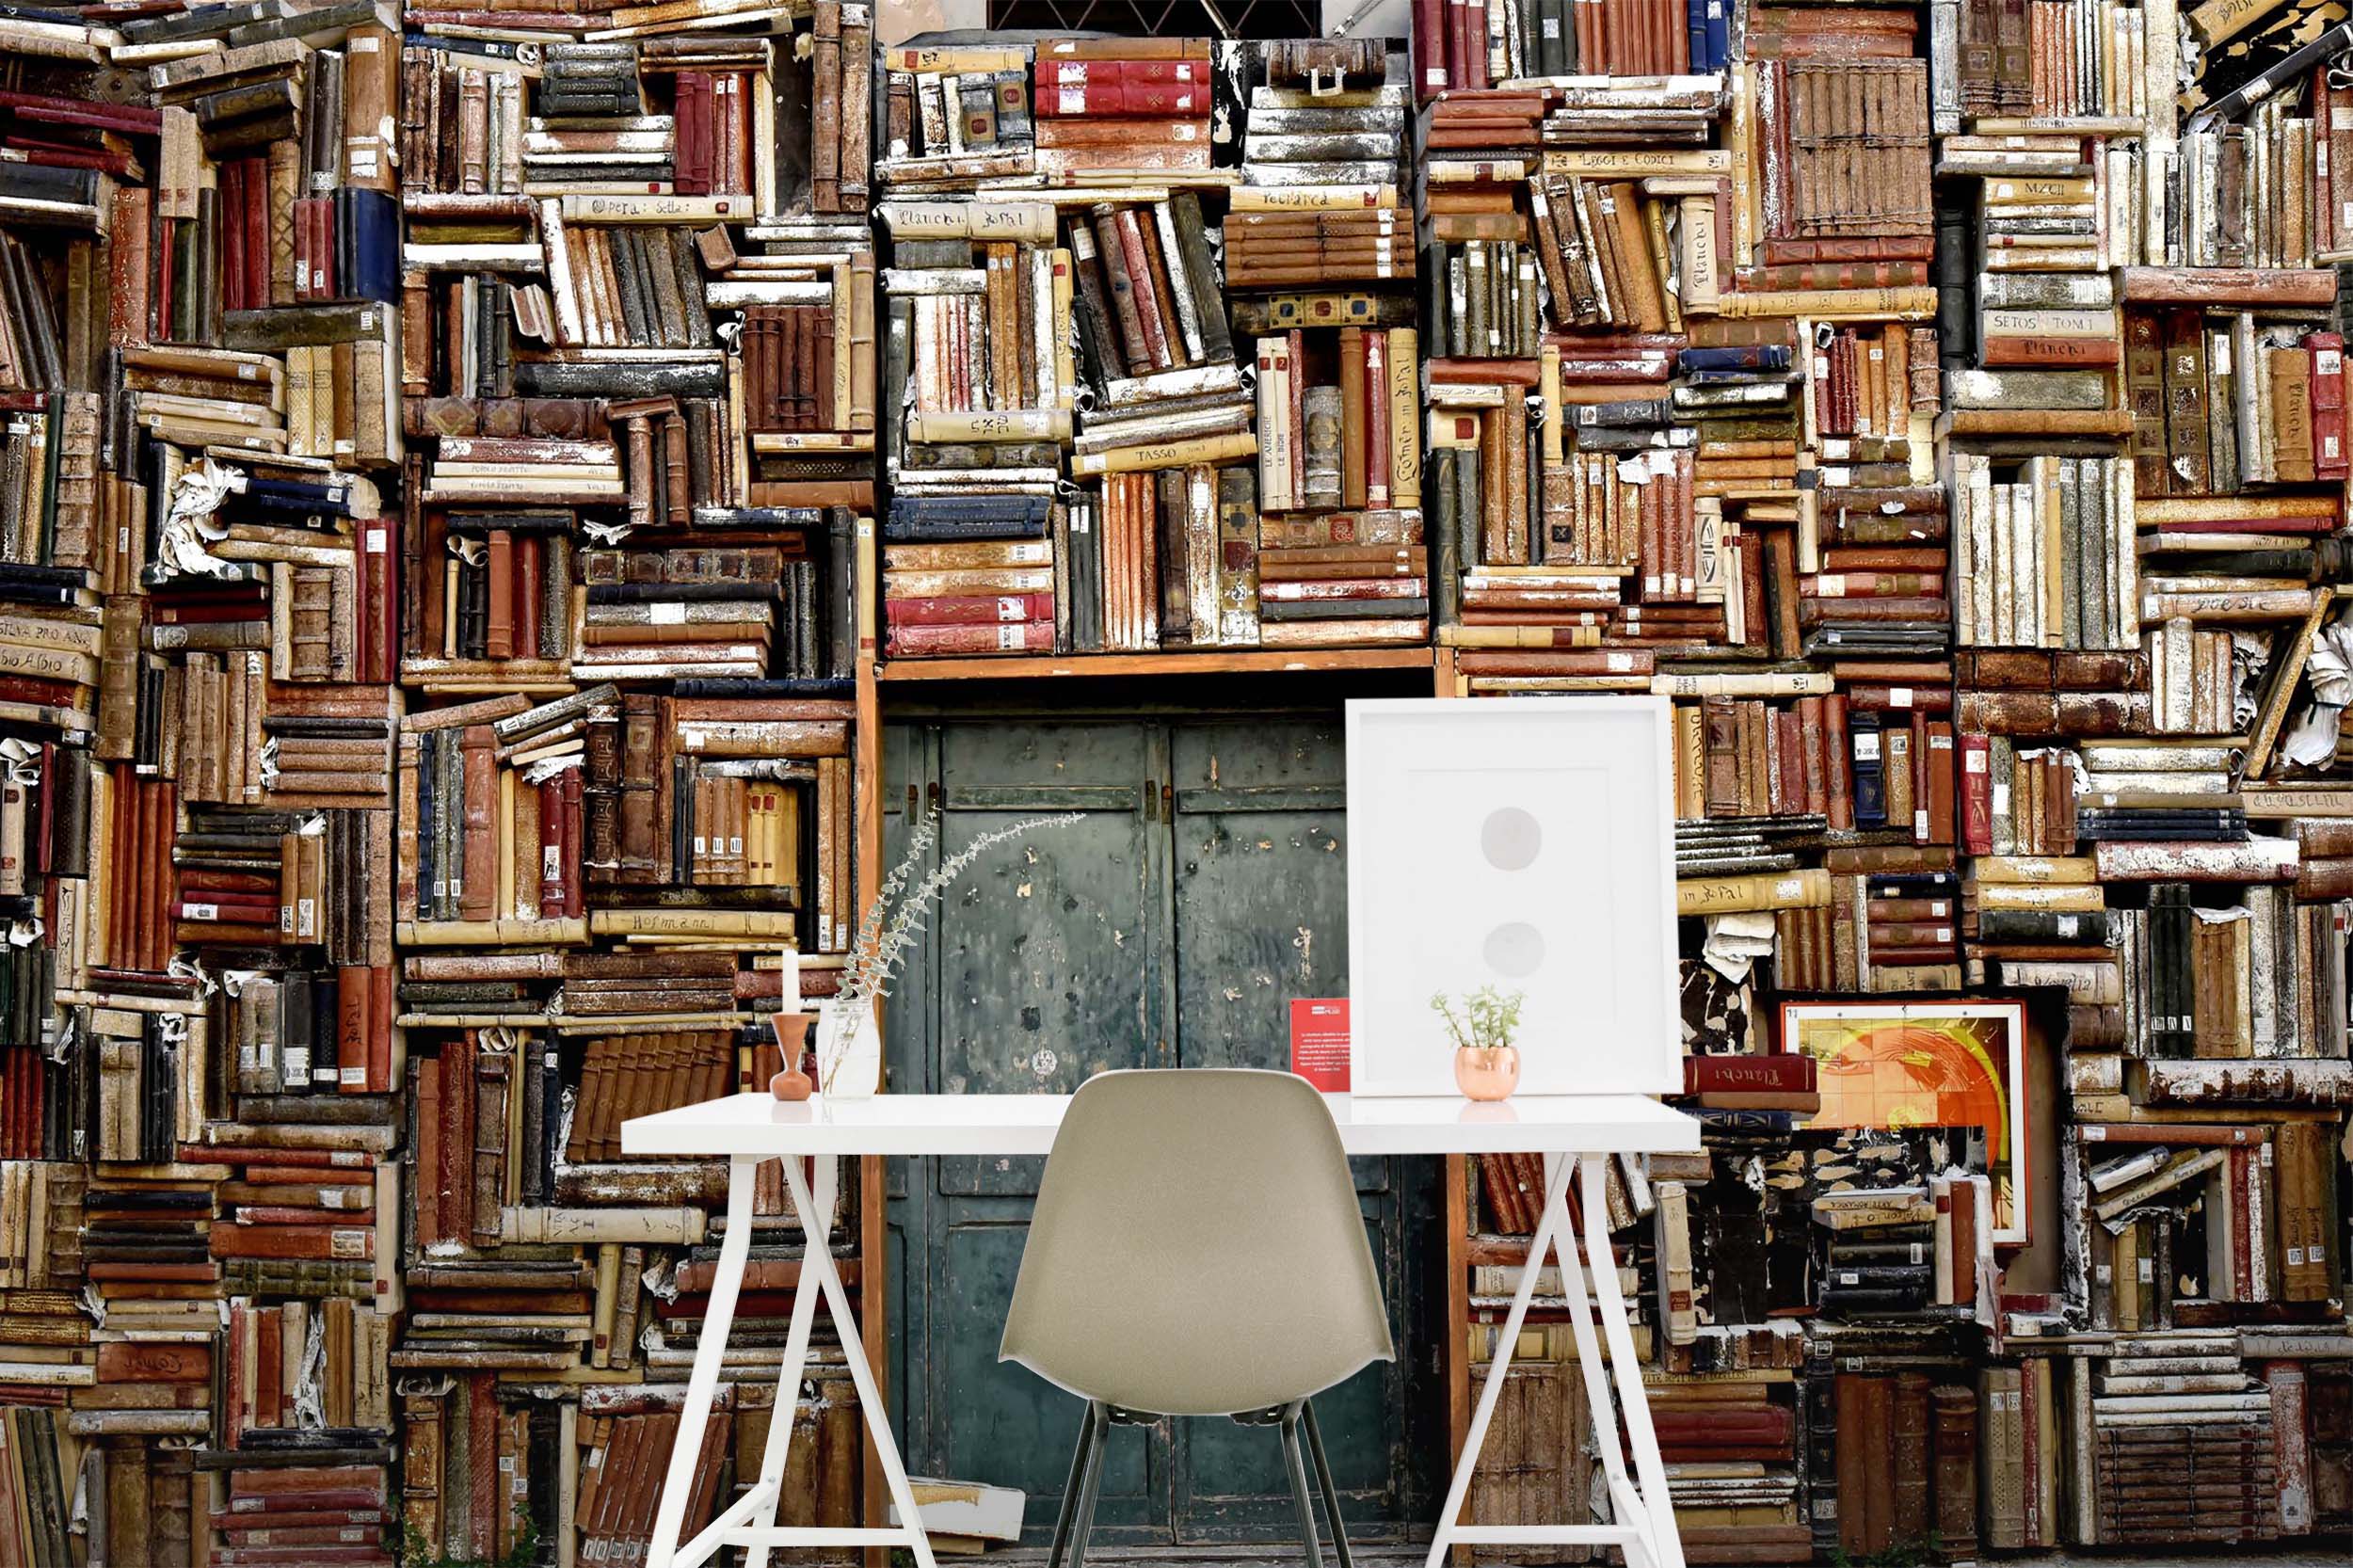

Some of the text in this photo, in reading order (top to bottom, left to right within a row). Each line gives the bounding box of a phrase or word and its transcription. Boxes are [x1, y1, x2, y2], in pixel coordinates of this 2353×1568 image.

[1994, 315, 2037, 329] SETOS
[2053, 317, 2084, 329] TOM
[1136, 448, 1177, 461] TASSO
